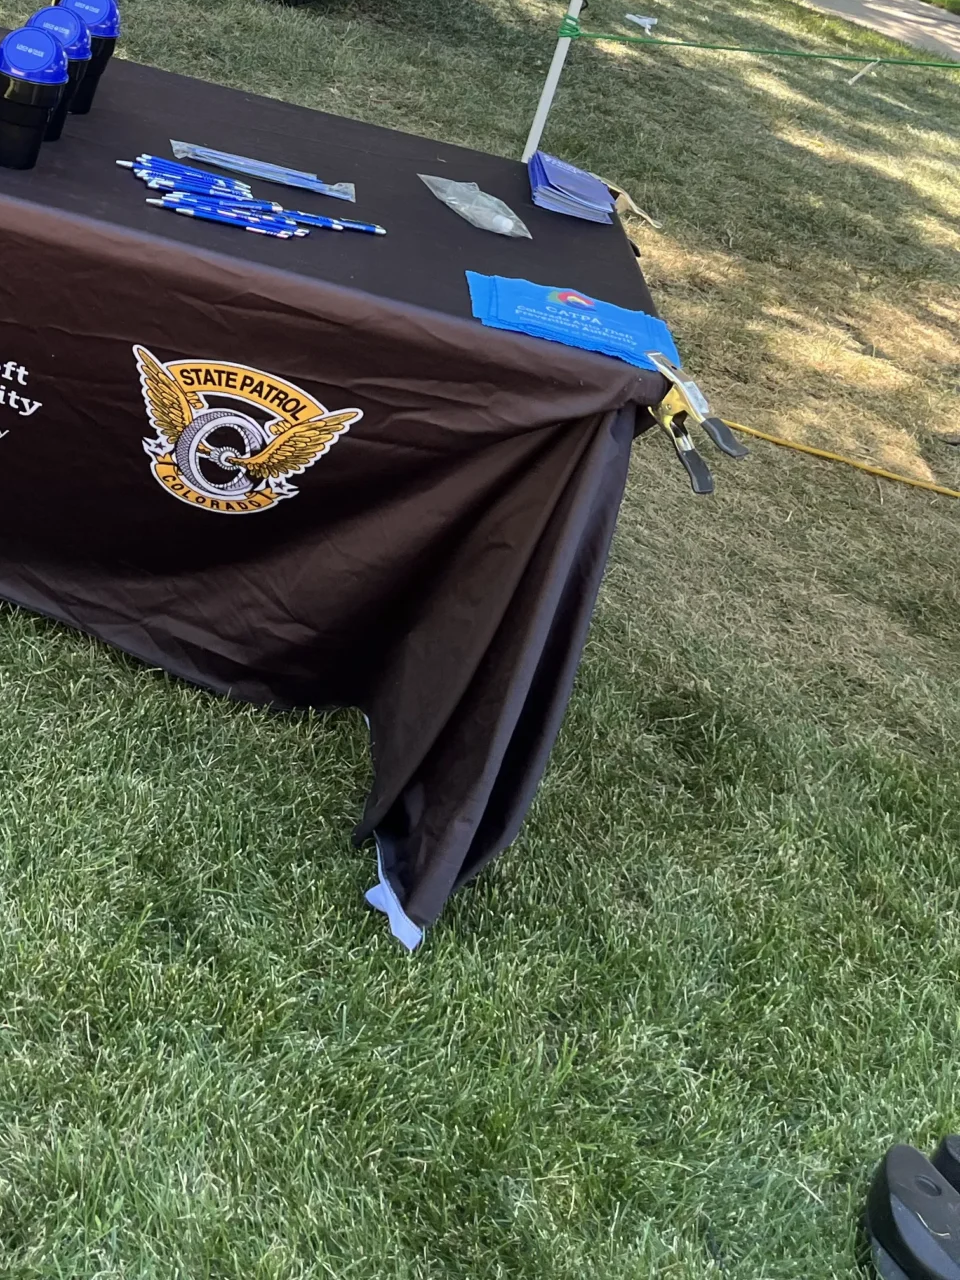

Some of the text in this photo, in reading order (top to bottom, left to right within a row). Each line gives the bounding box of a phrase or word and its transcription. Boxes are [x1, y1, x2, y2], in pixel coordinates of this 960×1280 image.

[180, 368, 308, 421] STATE PATROL
[162, 474, 262, 511] COLORADO
